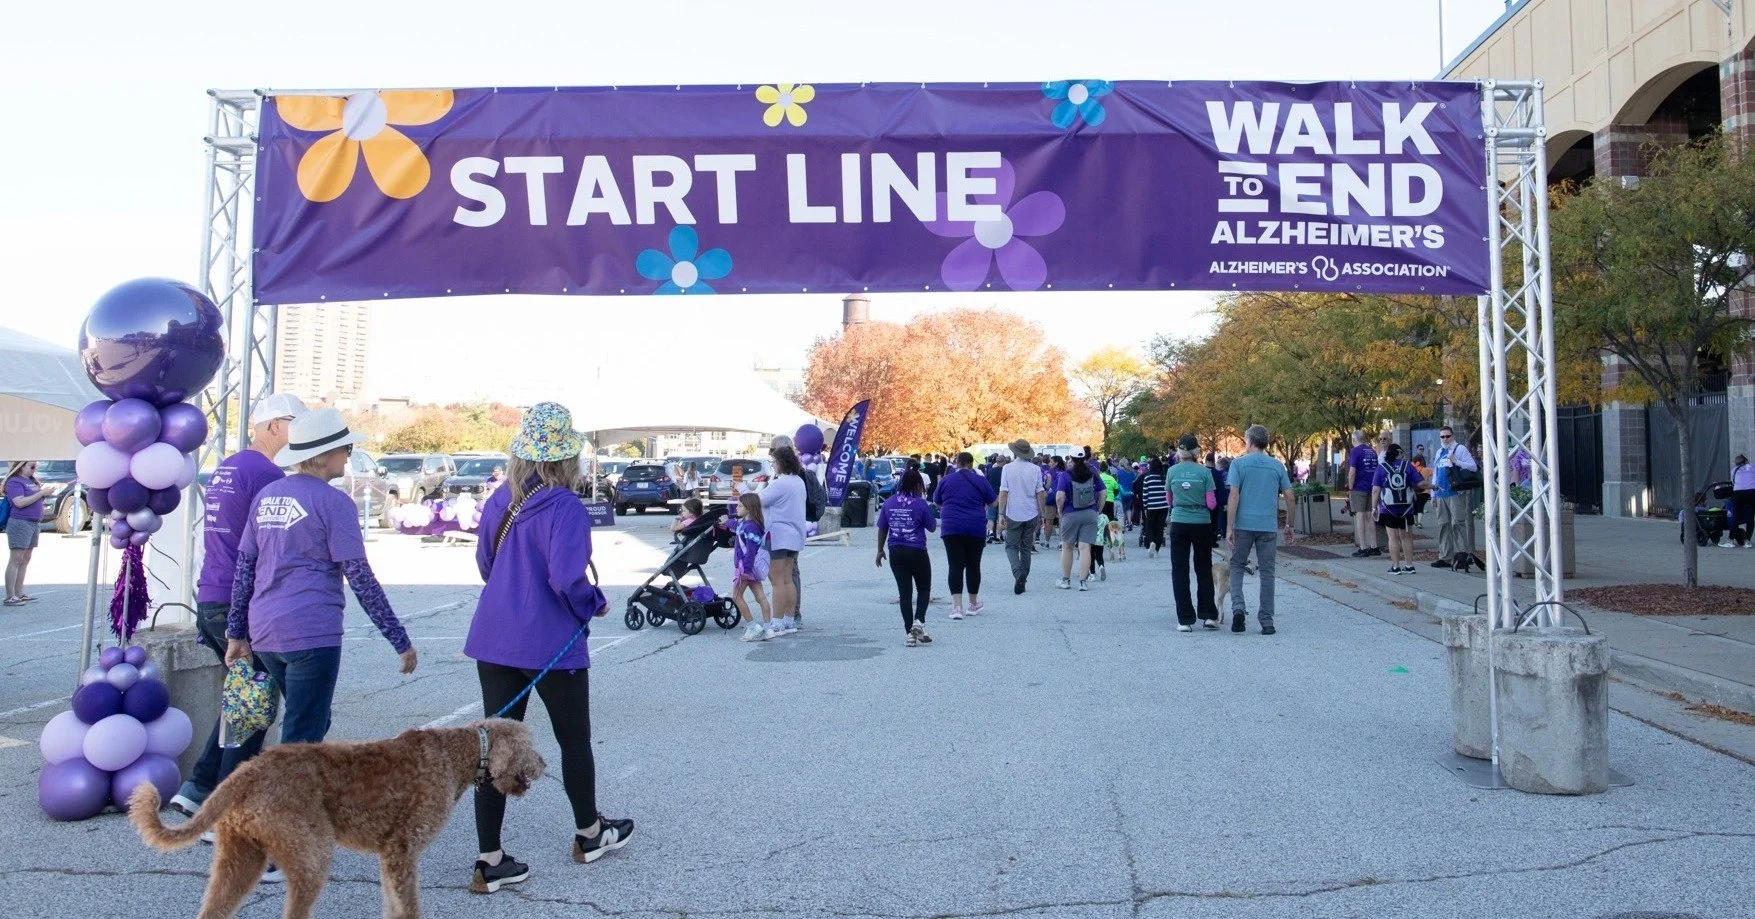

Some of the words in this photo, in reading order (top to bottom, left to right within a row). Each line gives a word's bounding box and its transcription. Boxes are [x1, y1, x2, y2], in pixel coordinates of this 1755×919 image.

[1205, 100, 1441, 155] WALK
[449, 153, 757, 228] START
[786, 151, 1002, 223] LINE
[1223, 176, 1264, 196] TO
[1278, 163, 1444, 217] END
[1210, 220, 1445, 249] ALZHEIMER'S
[1209, 261, 1308, 275] ALZHEIMER'S
[1342, 262, 1448, 277] ASSOCIATION
[835, 414, 861, 484] WELCOME
[258, 506, 288, 516] END
[281, 496, 292, 506] TO
